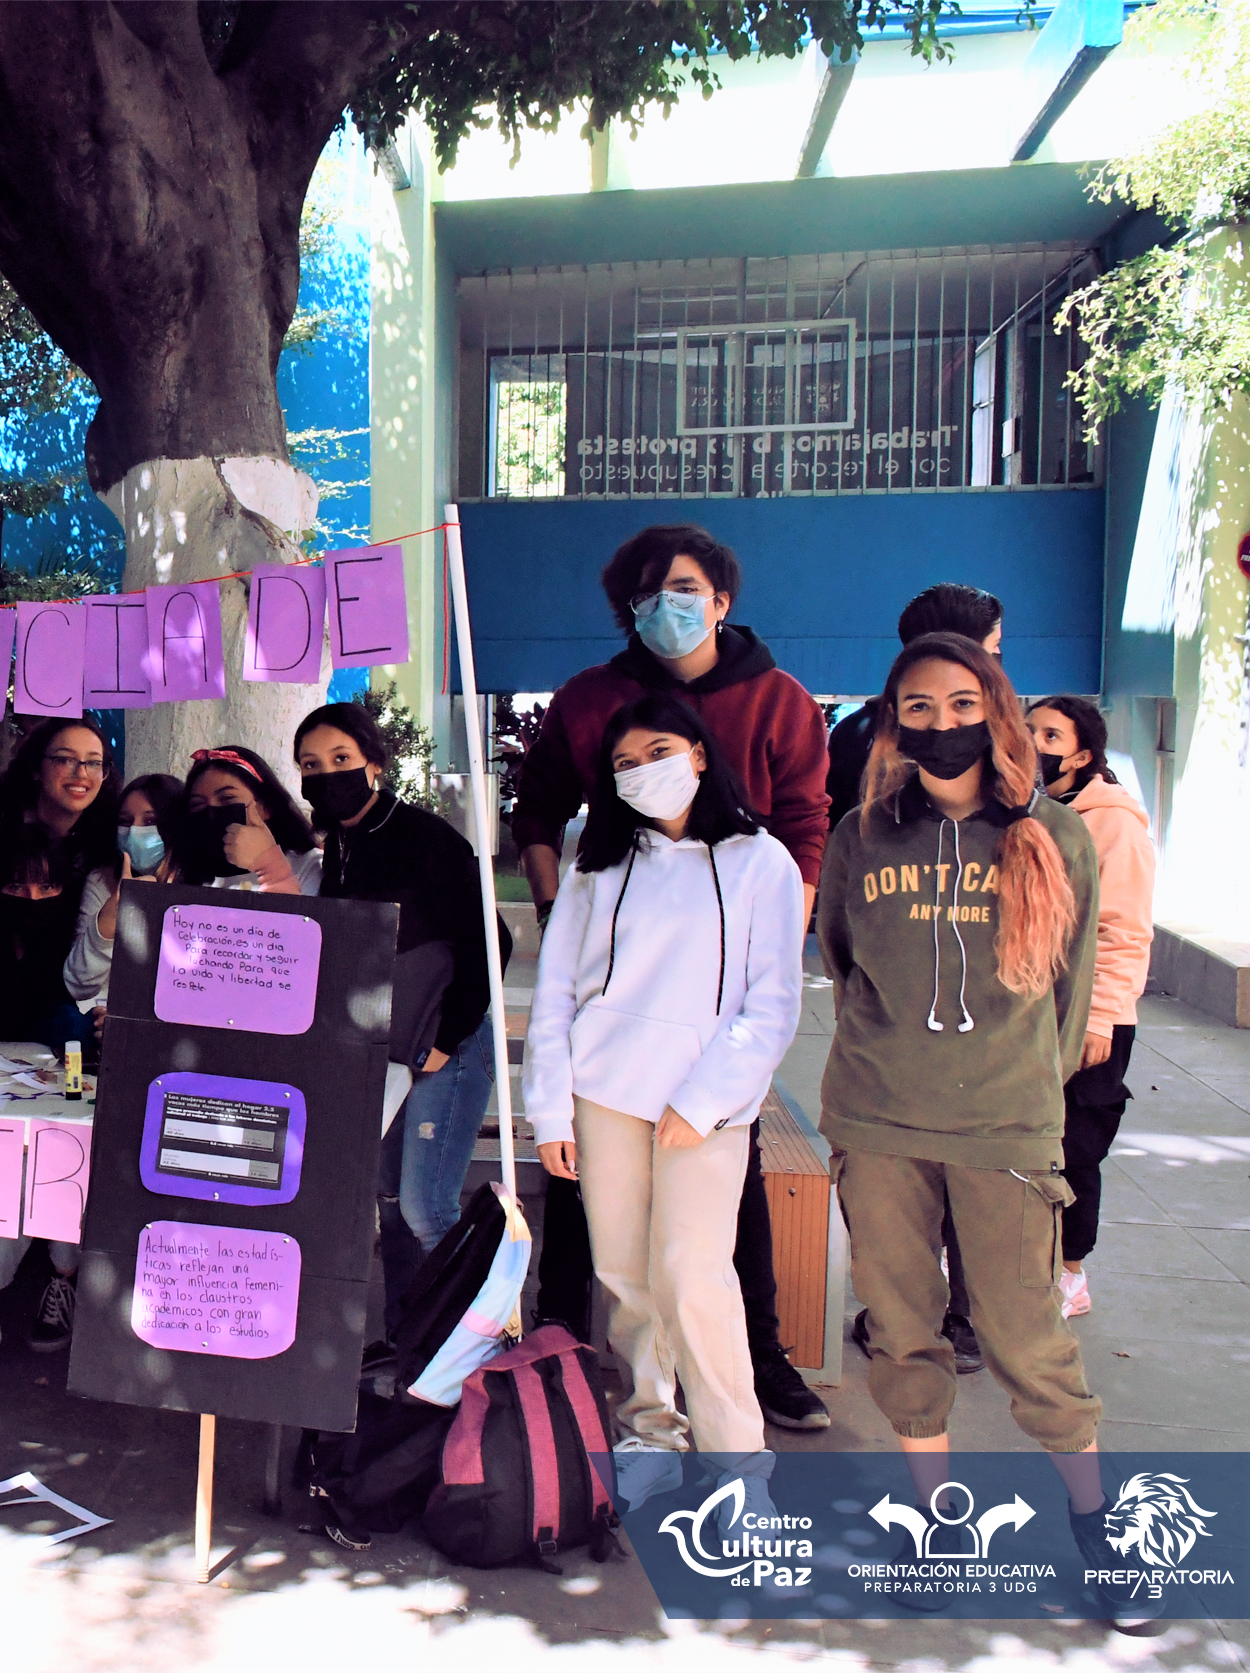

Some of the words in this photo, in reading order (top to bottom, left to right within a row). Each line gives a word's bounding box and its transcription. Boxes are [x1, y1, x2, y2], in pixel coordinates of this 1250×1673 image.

[256, 556, 392, 671] DE
[864, 864, 950, 902] DON'T
[963, 862, 1000, 894] CA
[909, 904, 942, 920] ANY
[947, 906, 990, 922] MORE
[173, 913, 194, 929] Hoy
[199, 922, 212, 931] no
[268, 929, 281, 939] de
[213, 948, 252, 960] recordar
[189, 956, 234, 970] luchando
[271, 966, 290, 976] que
[172, 965, 186, 975] la
[192, 969, 213, 979] vida
[231, 973, 273, 989] libertad
[278, 981, 292, 991] se
[145, 1235, 210, 1258] Actualmente
[218, 1240, 234, 1257] las
[144, 1254, 172, 1270] ticas
[180, 1258, 224, 1276] reflejan
[143, 1271, 179, 1289] mayor
[188, 1275, 239, 1289] influencia
[141, 1287, 153, 1298] na
[160, 1290, 172, 1301] en
[177, 1288, 193, 1301] los
[200, 1291, 252, 1305] claustros
[142, 1302, 203, 1317] académicos
[210, 1307, 230, 1319] con
[235, 1308, 262, 1324] gran
[141, 1316, 190, 1330] dedicación
[194, 1323, 202, 1331] a
[206, 1320, 222, 1334] los
[230, 1323, 269, 1339] estudios
